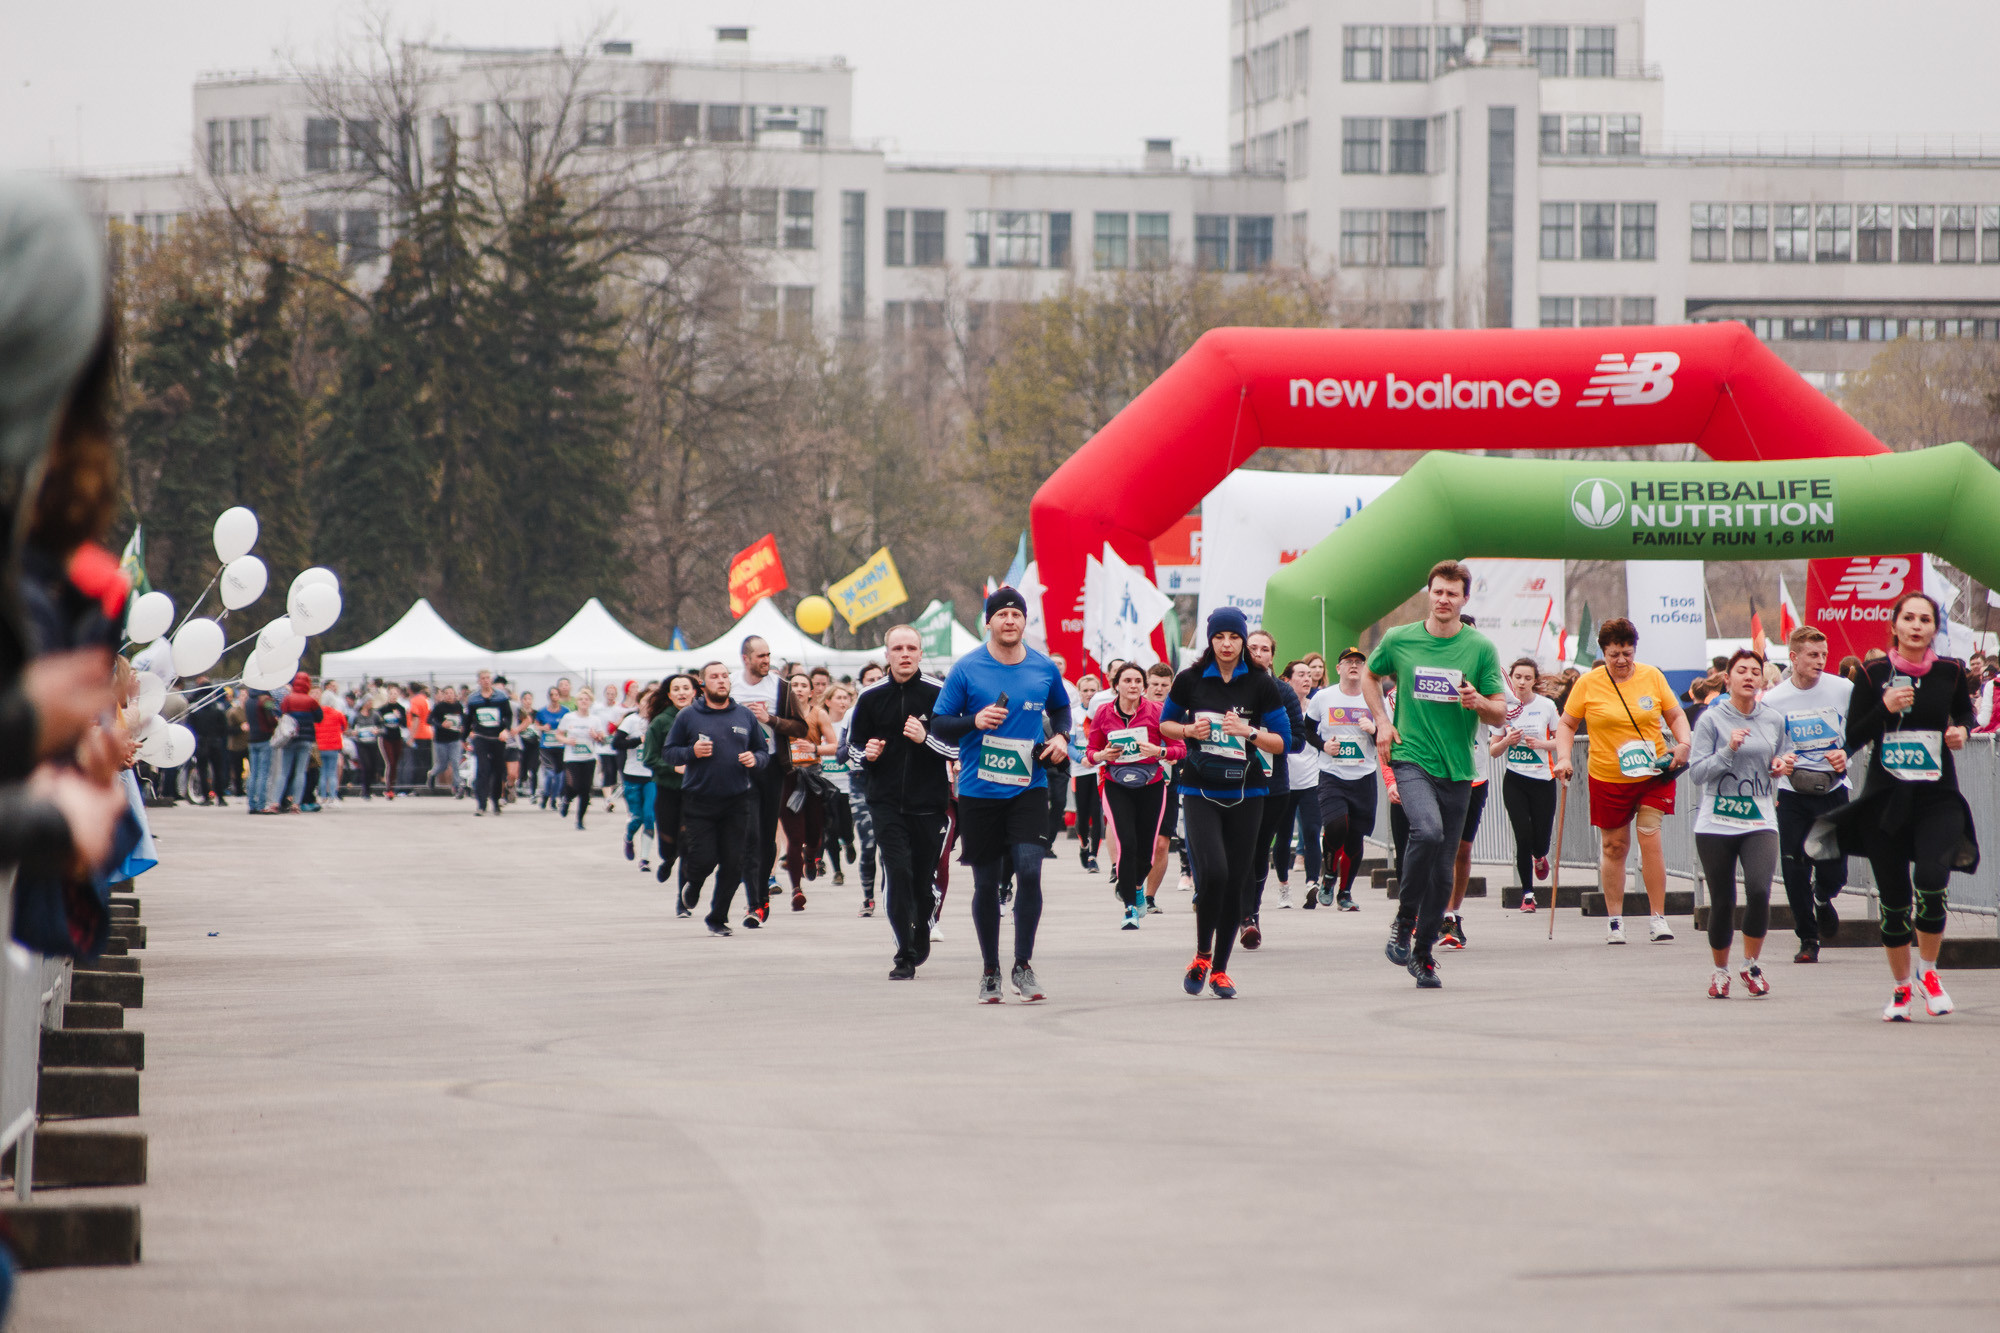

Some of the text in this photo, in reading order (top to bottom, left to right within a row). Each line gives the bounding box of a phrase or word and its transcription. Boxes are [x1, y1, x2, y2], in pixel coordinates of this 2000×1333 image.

[1289, 372, 1561, 410] new balance
[1630, 479, 1833, 502] HERBALIFE
[1630, 501, 1834, 528] NUTRITION
[1632, 529, 1834, 547] FAMILY RUN 1,6 KM
[1226, 594, 1263, 607] Твоя
[1659, 595, 1696, 608] Твоя
[1650, 609, 1703, 625] победа
[1817, 606, 1848, 622] new
[1418, 679, 1450, 693] 5525
[1793, 723, 1824, 738] 9148
[984, 753, 1017, 770] 1269
[1508, 749, 1534, 761] 2034
[1622, 753, 1649, 768] 3100
[1884, 748, 1925, 766] 2373
[1716, 797, 1753, 815] 2747
